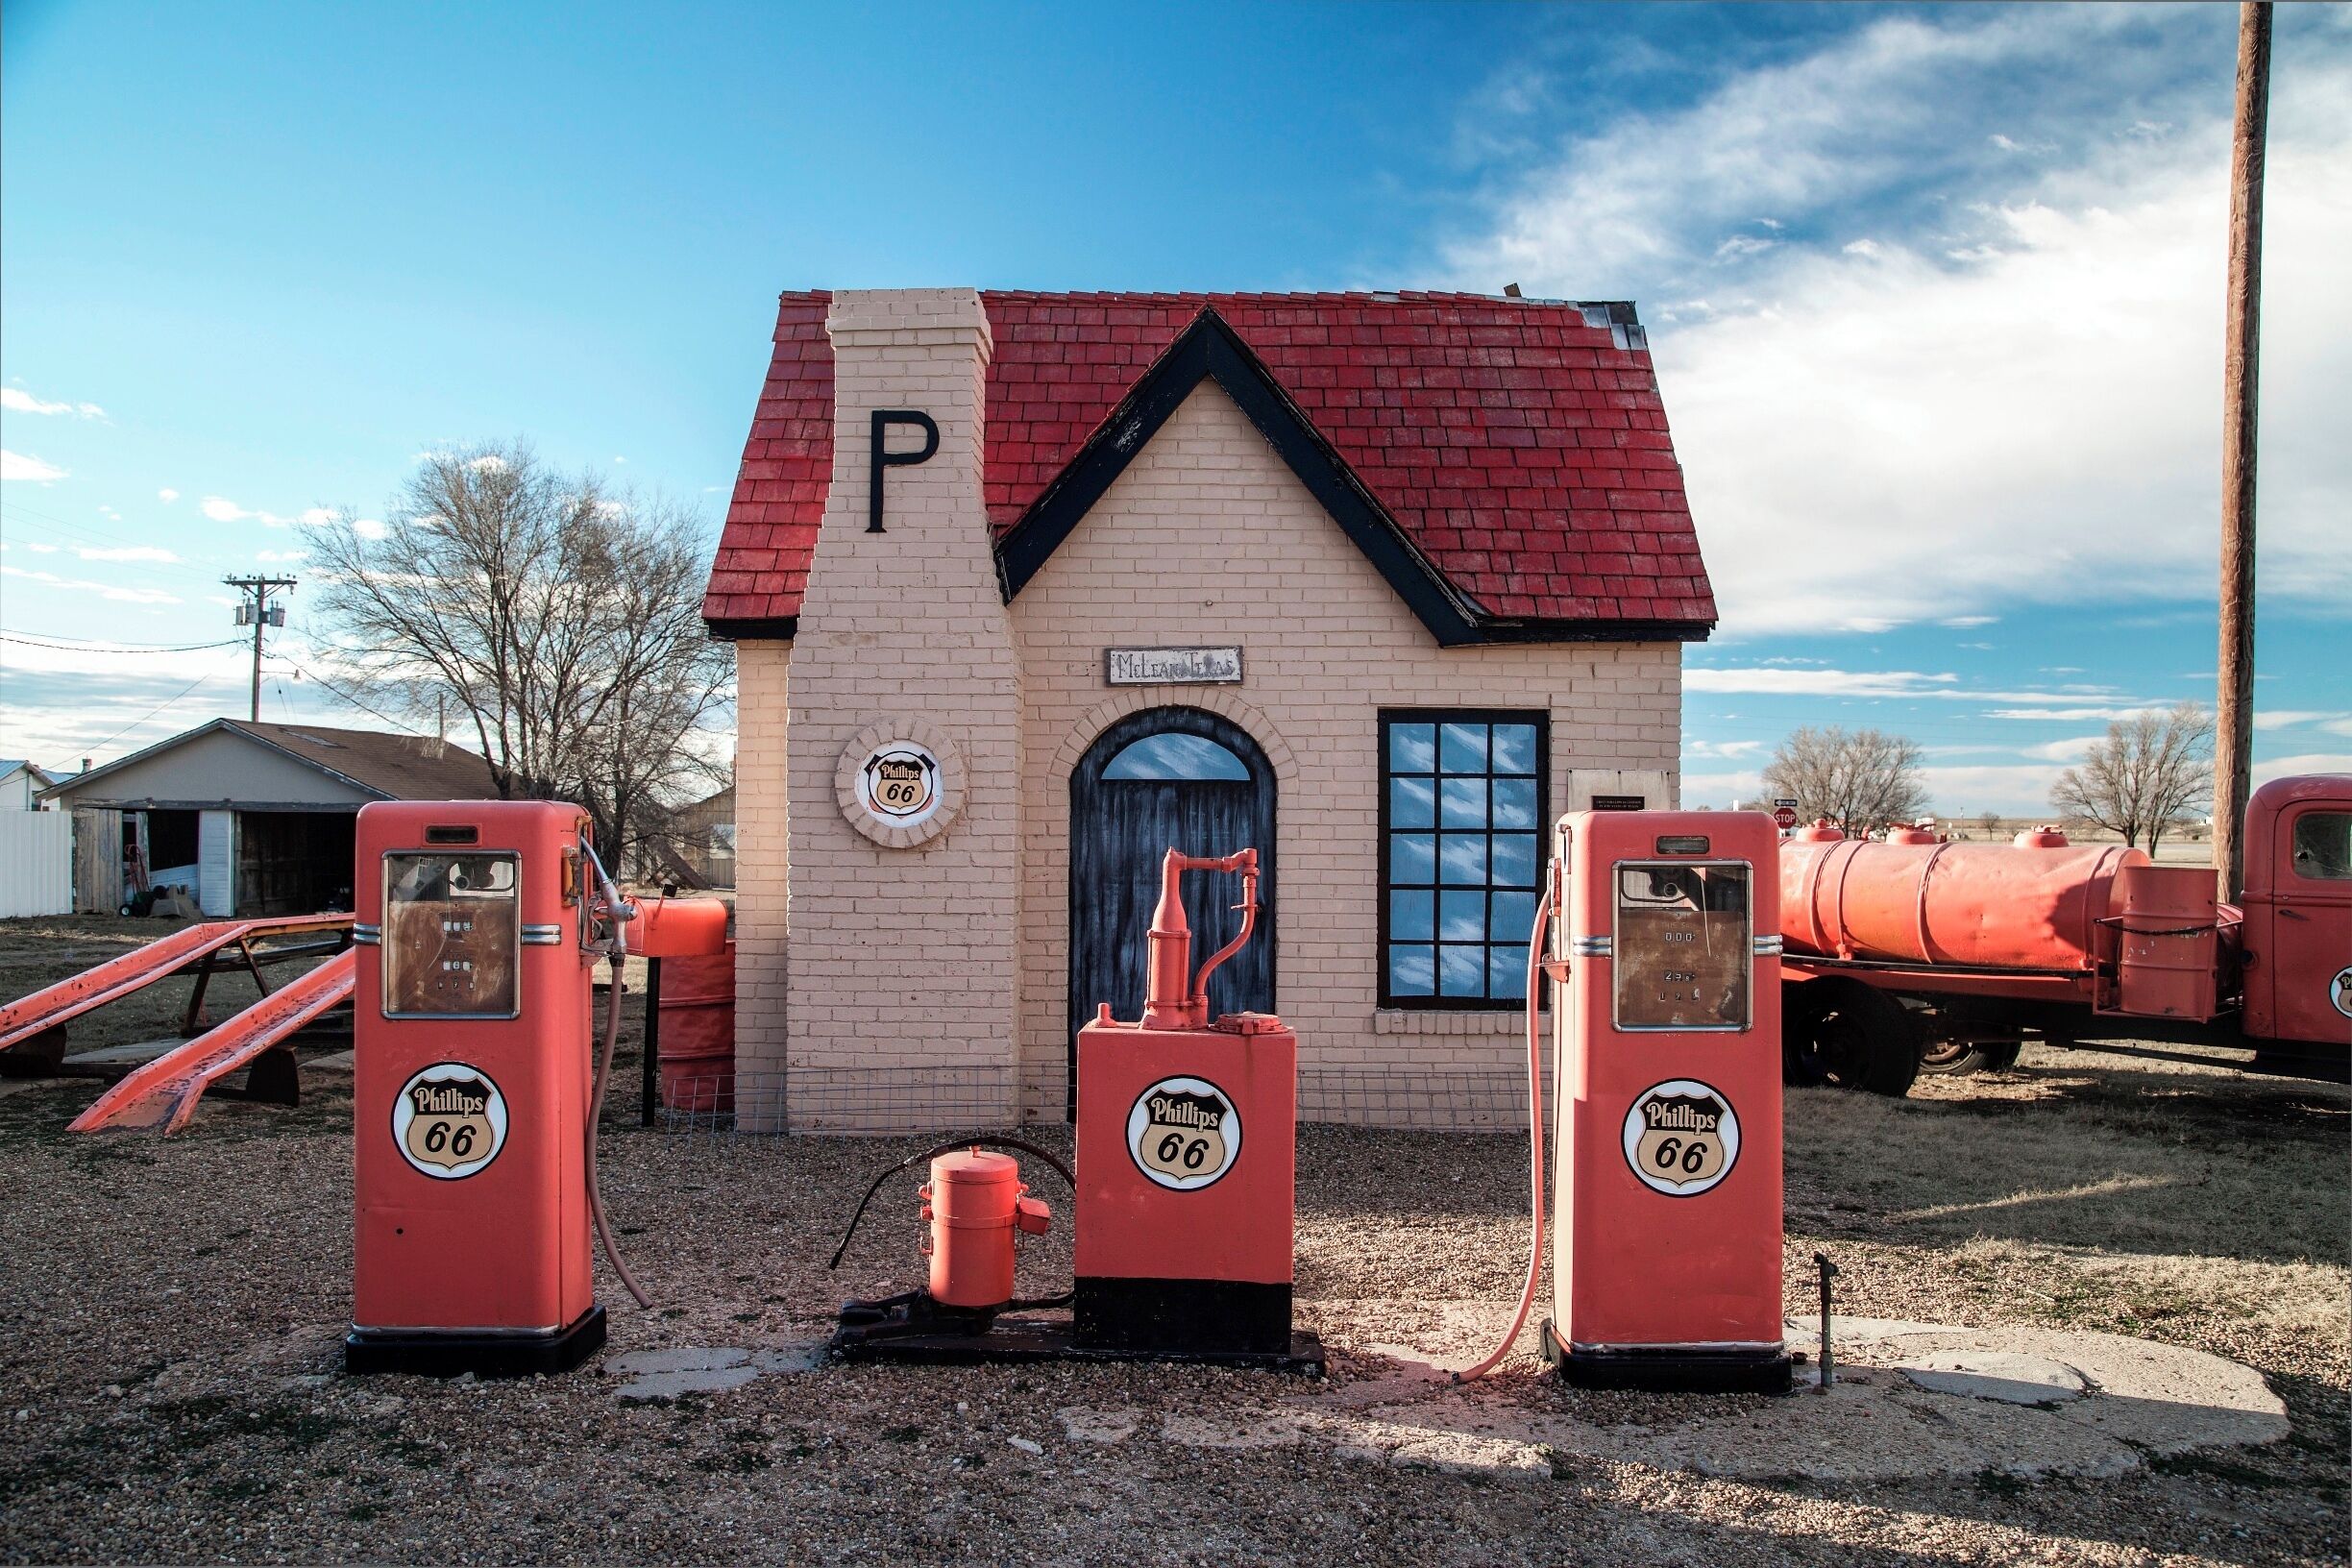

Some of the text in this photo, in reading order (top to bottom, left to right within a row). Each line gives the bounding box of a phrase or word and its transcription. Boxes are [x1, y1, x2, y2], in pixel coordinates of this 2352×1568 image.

[865, 410, 940, 532] P
[881, 764, 919, 782] Phillips
[887, 783, 916, 802] 66
[1776, 814, 1796, 822] STOP
[414, 1088, 483, 1118] Phillips
[1151, 1097, 1218, 1133] Phillips
[1646, 1102, 1716, 1136] Phillips
[426, 1121, 478, 1156] 66
[1158, 1133, 1209, 1169] 66
[1655, 1138, 1707, 1173] 66
